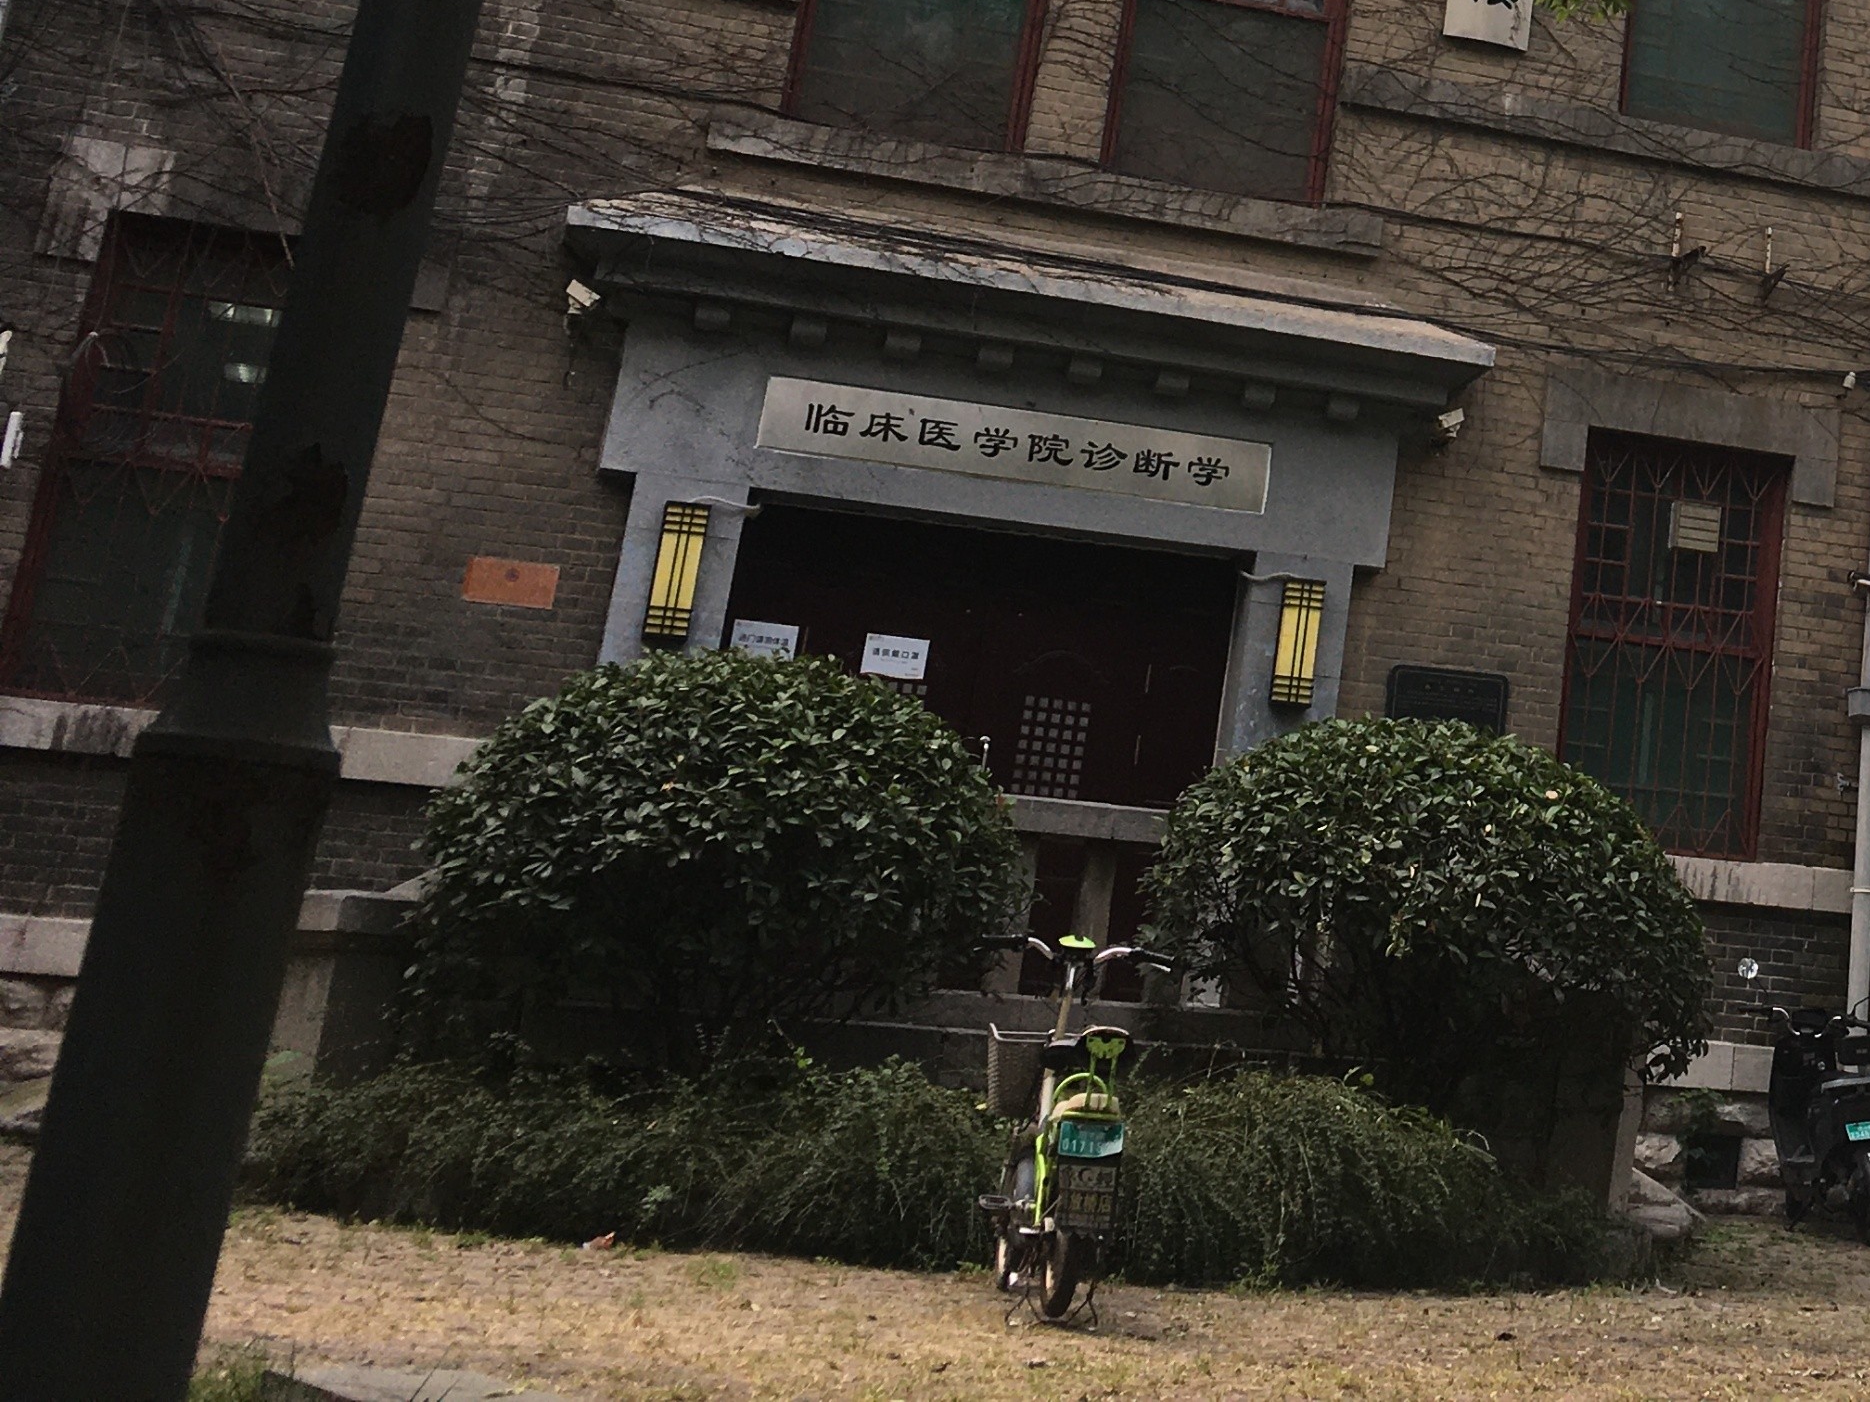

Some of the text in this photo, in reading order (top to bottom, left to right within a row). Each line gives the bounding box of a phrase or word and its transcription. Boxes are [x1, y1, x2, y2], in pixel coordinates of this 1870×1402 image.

[803, 402, 1231, 488] 临床医学院诊断学
